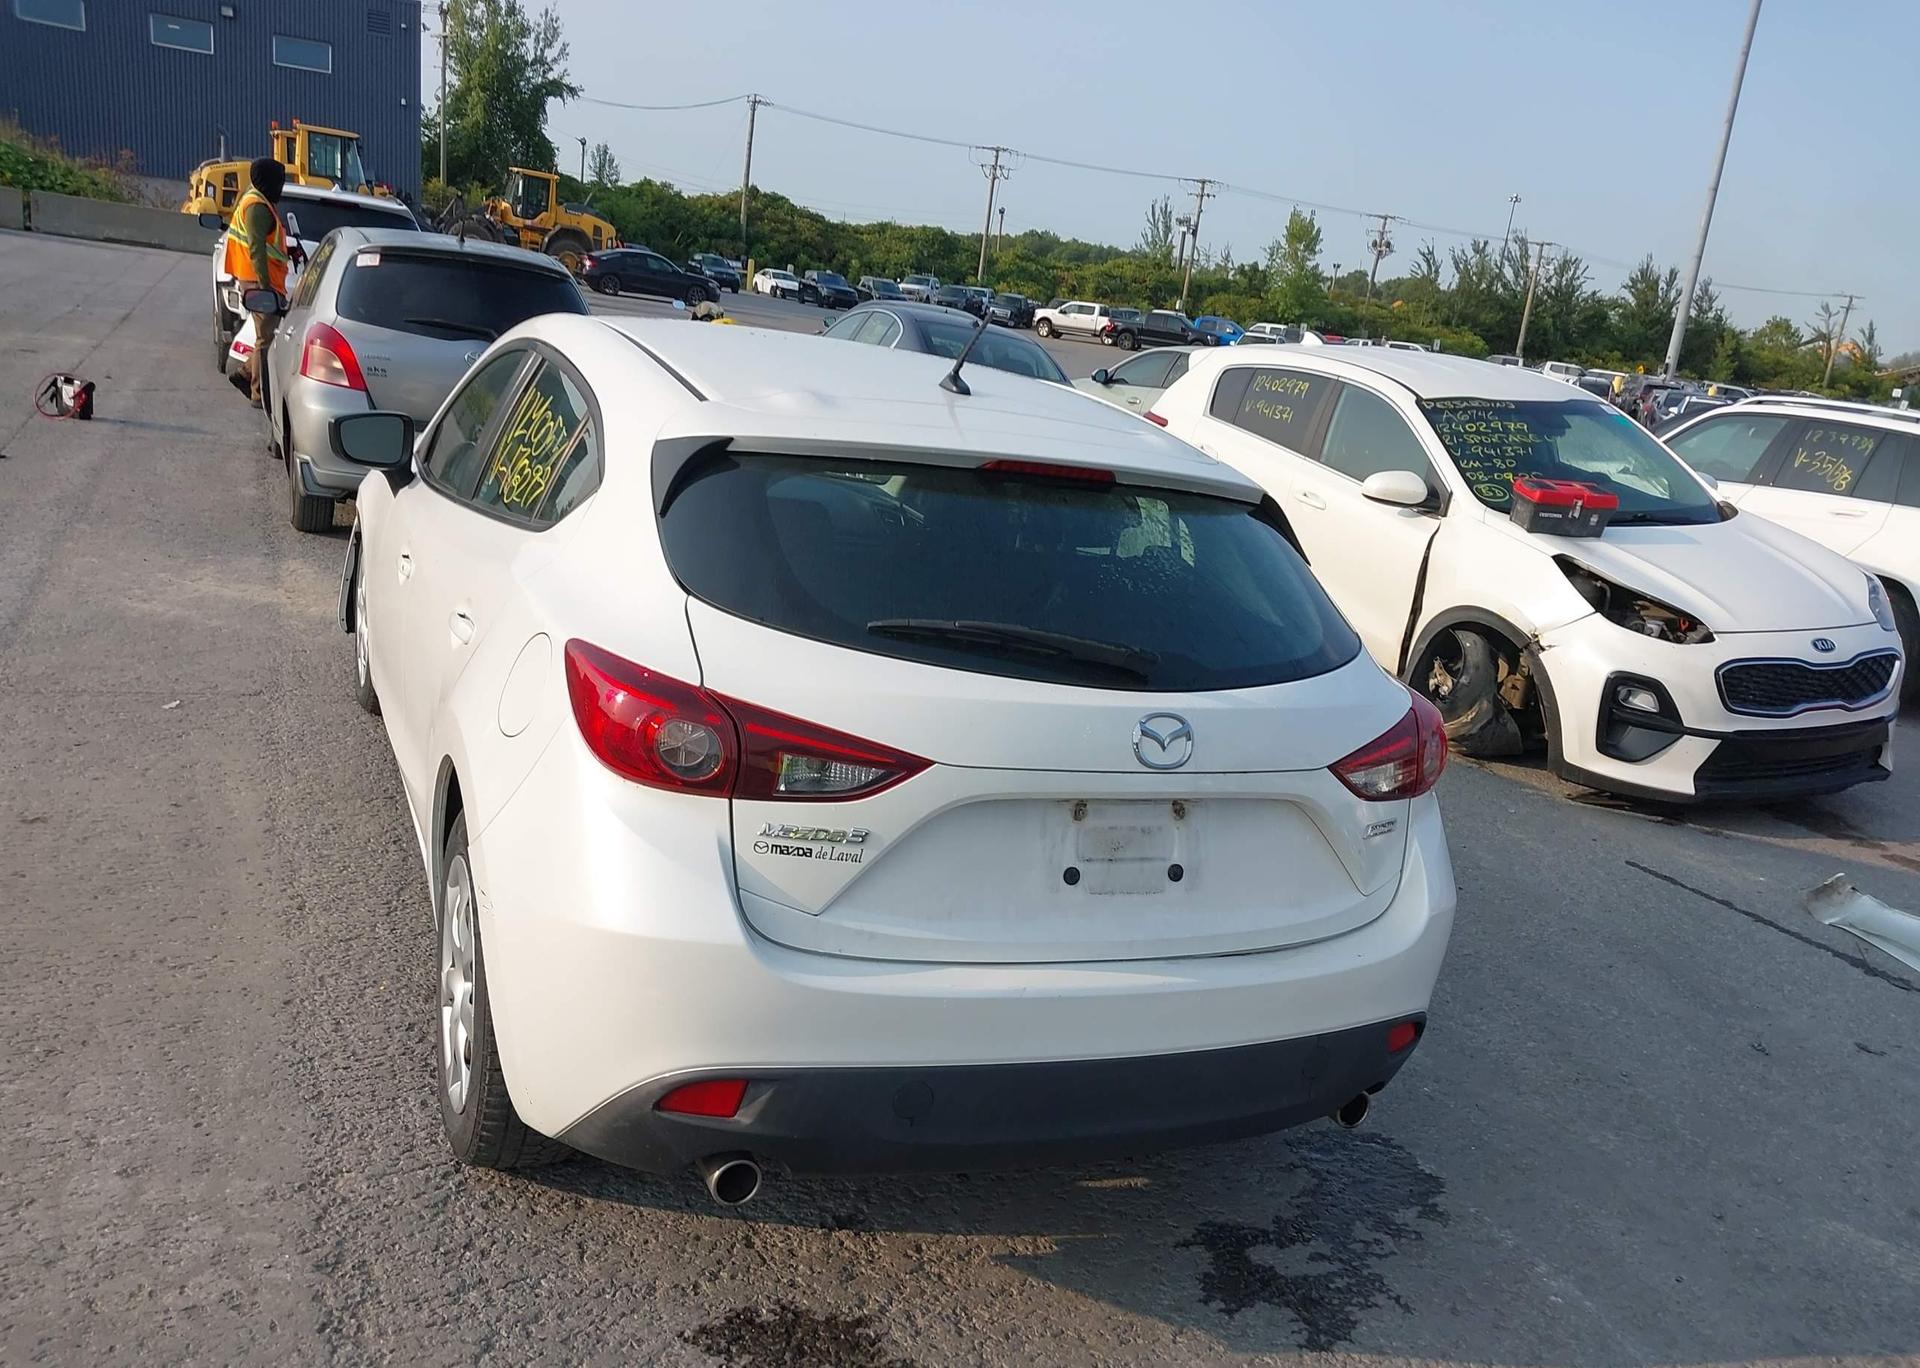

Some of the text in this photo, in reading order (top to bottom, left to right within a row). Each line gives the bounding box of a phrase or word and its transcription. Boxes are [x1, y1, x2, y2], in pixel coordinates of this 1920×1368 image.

[1253, 375, 1310, 399] 12402979
[1436, 421, 1529, 434] 12402979
[1814, 640, 1835, 650] KIA
[770, 843, 865, 864] mazda de Laval
